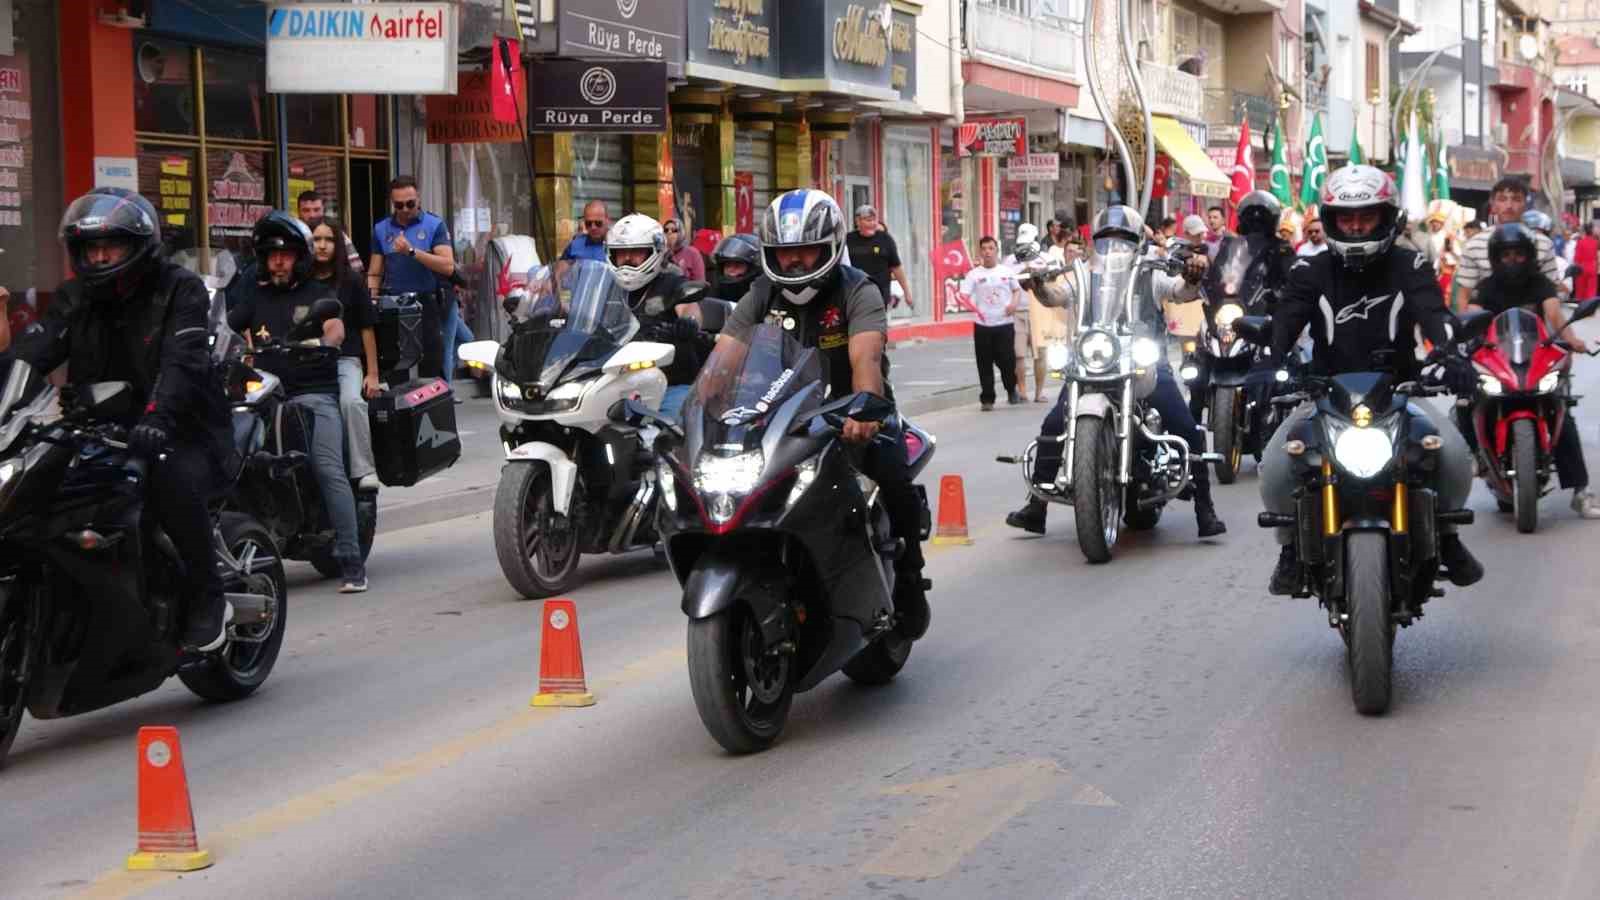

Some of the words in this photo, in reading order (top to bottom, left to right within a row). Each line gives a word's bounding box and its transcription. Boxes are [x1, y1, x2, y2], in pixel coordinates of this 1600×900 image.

[288, 9, 364, 38] DAIKIN
[384, 9, 443, 38] airfel
[588, 22, 620, 50] Rüya
[627, 30, 663, 57] Perde
[545, 110, 589, 126] Rüya
[601, 110, 653, 124] Perde
